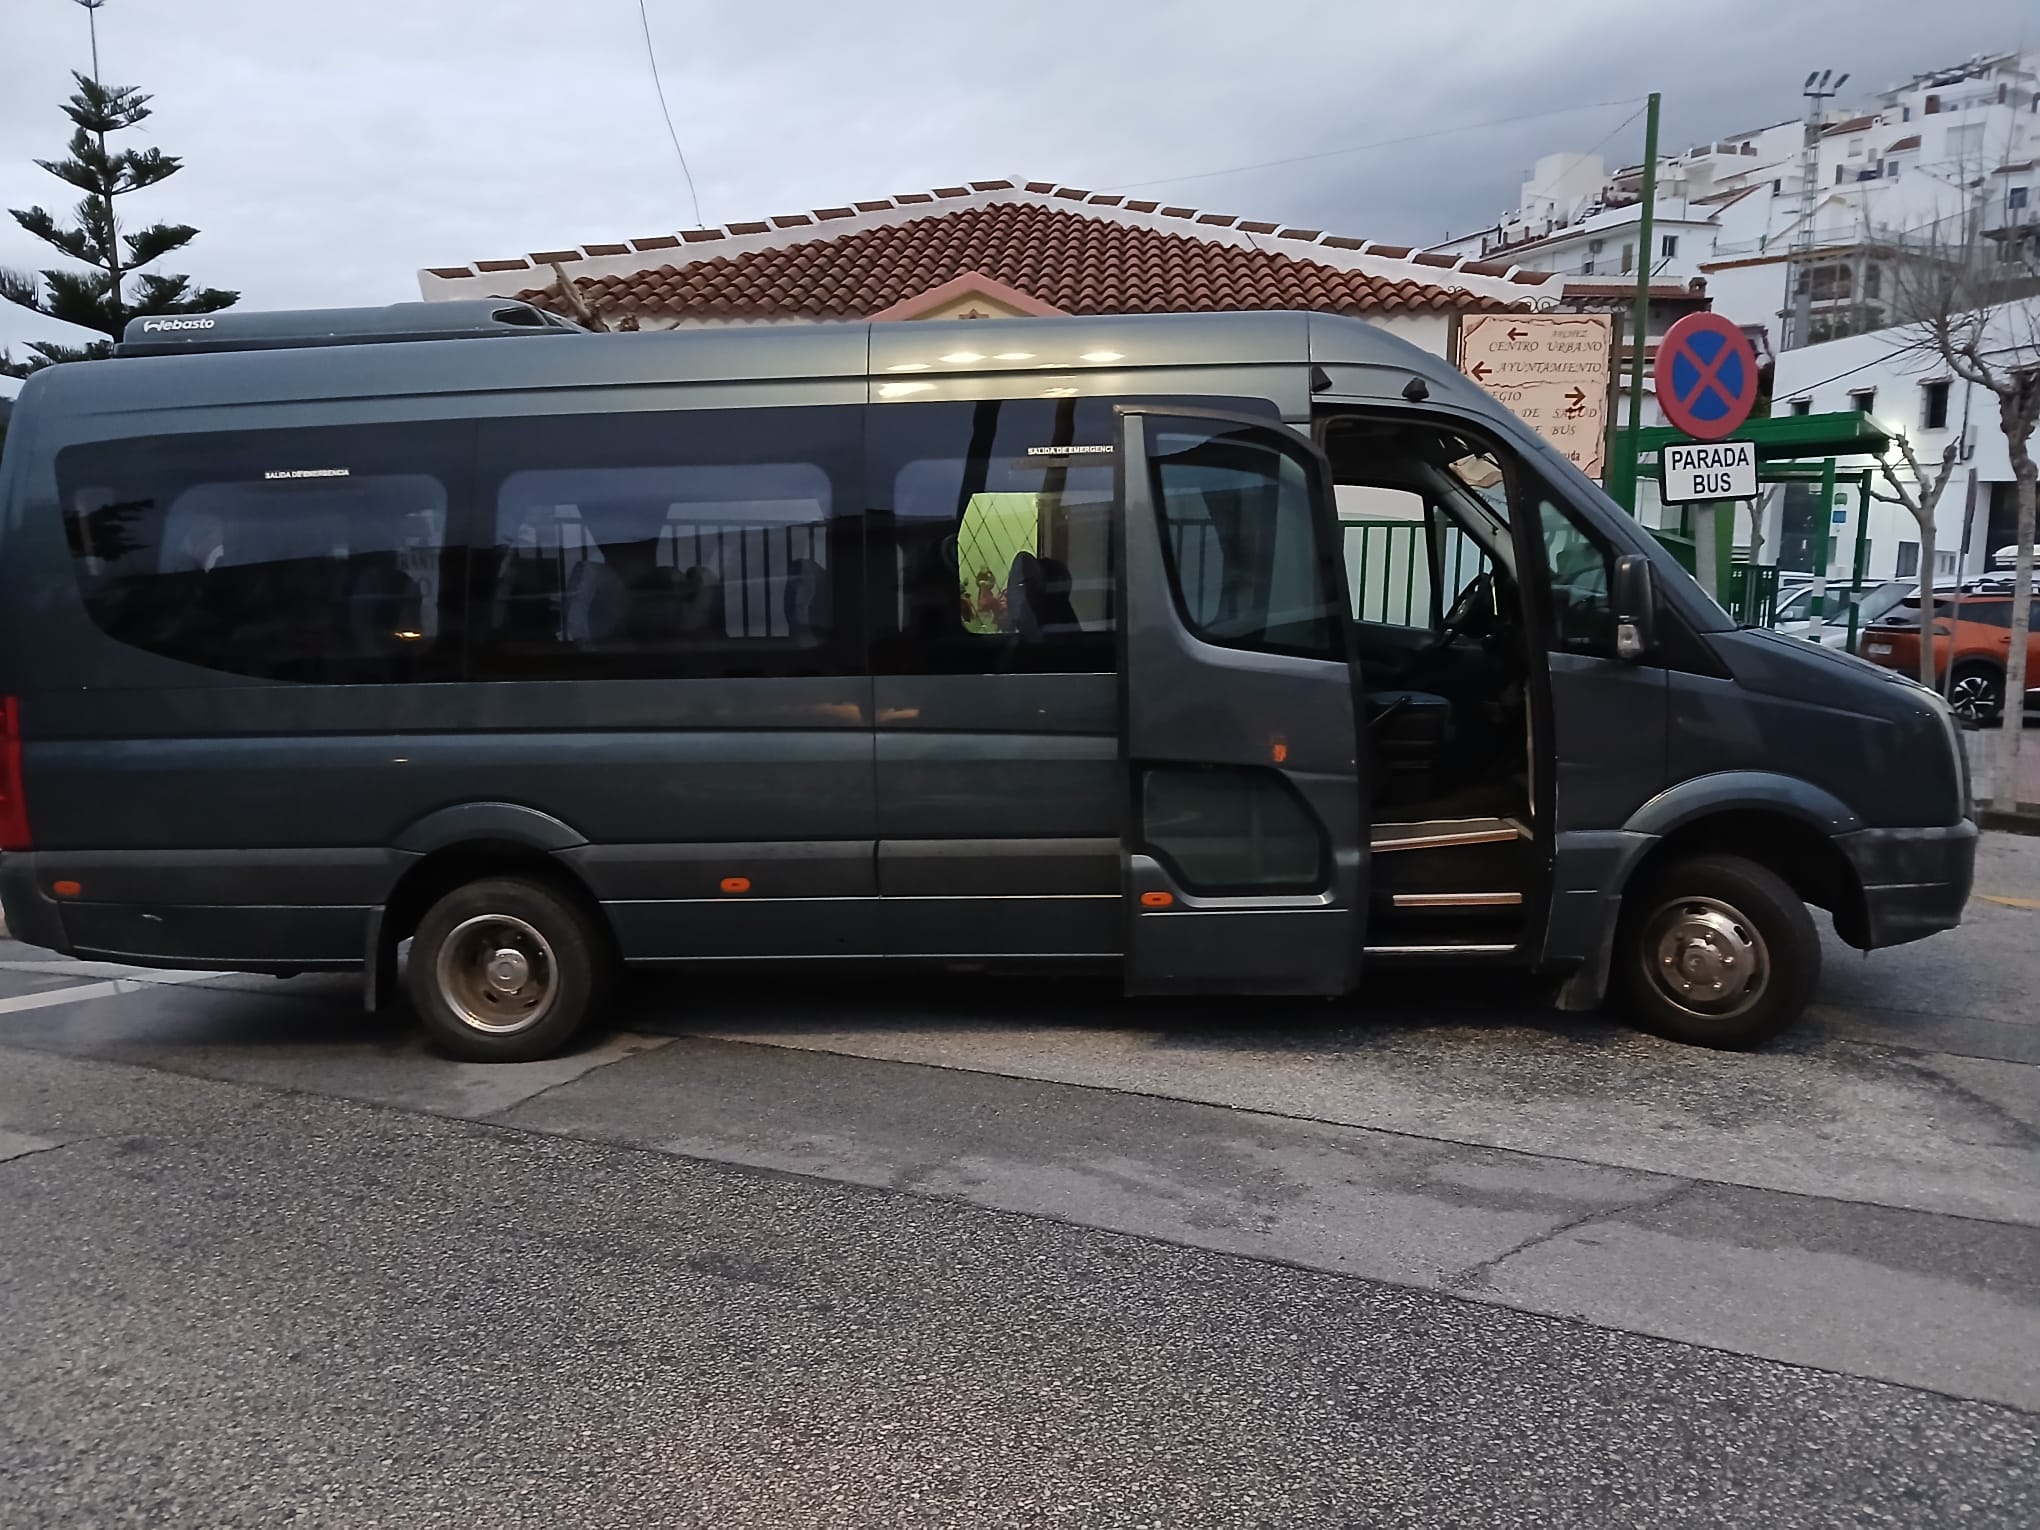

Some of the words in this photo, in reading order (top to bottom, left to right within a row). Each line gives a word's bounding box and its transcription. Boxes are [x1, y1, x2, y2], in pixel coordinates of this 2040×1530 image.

[143, 319, 215, 333] Webasto
[1489, 341, 1539, 352] CENTRO
[1547, 341, 1602, 352] URBANO
[1497, 362, 1602, 373] AYUNTAMIENTO
[1522, 408, 1540, 418] DE
[1552, 426, 1576, 435] BUS
[1069, 446, 1114, 454] EMERGENCI
[1672, 447, 1750, 470] PARADA
[1694, 473, 1731, 494] BUS
